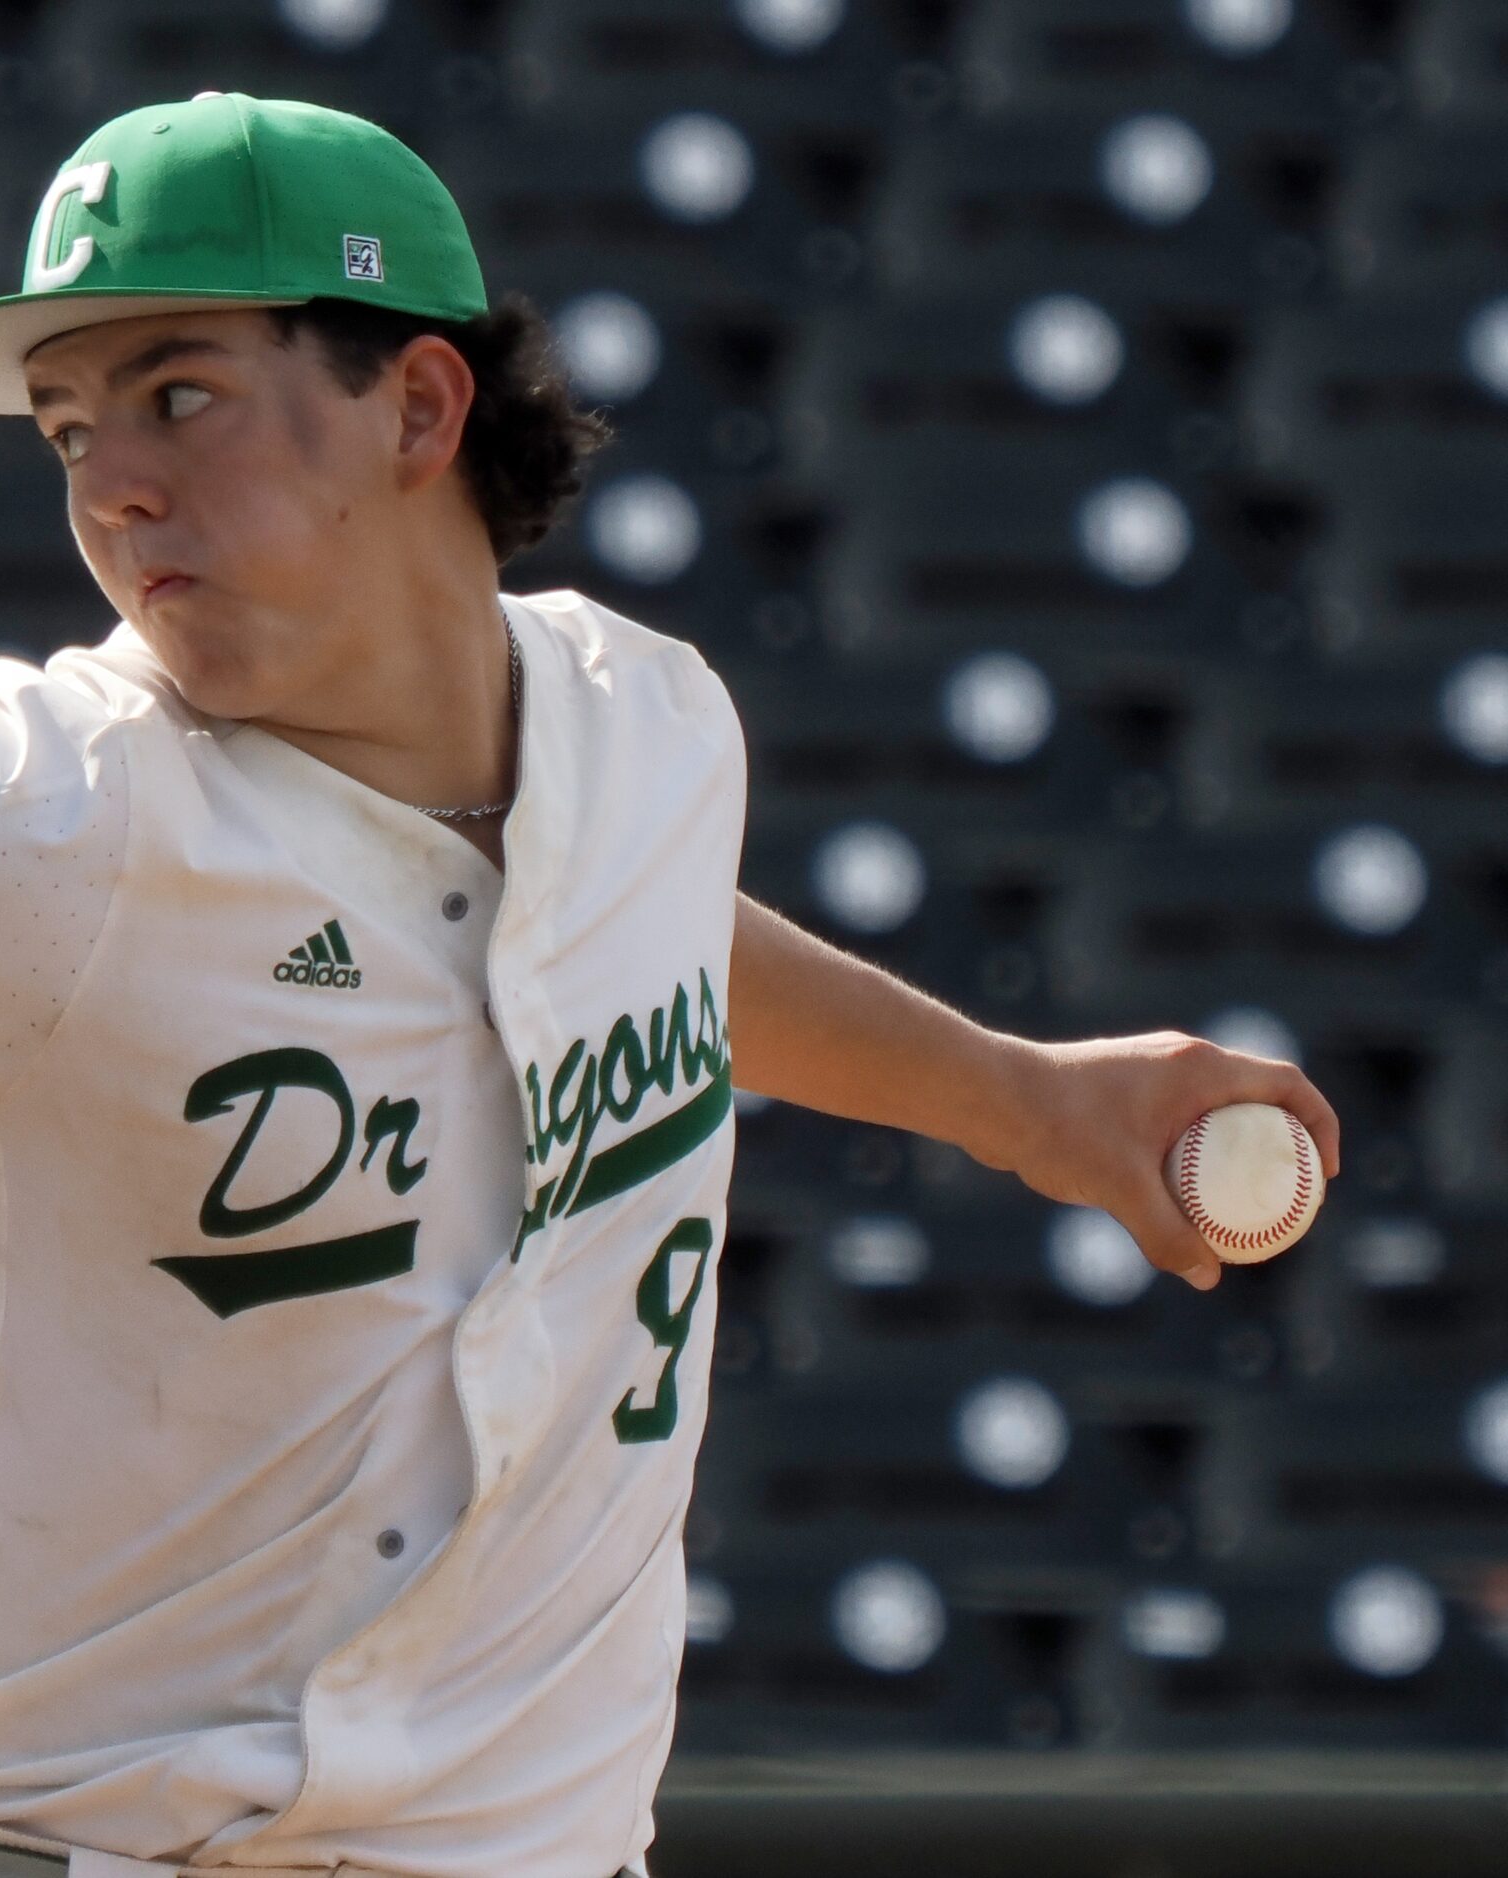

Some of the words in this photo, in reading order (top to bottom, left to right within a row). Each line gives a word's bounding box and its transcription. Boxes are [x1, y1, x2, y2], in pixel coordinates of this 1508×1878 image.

[32, 162, 112, 291] C
[273, 960, 362, 990] adidas
[184, 1047, 428, 1239] Dr
[612, 1216, 713, 1444] 9
